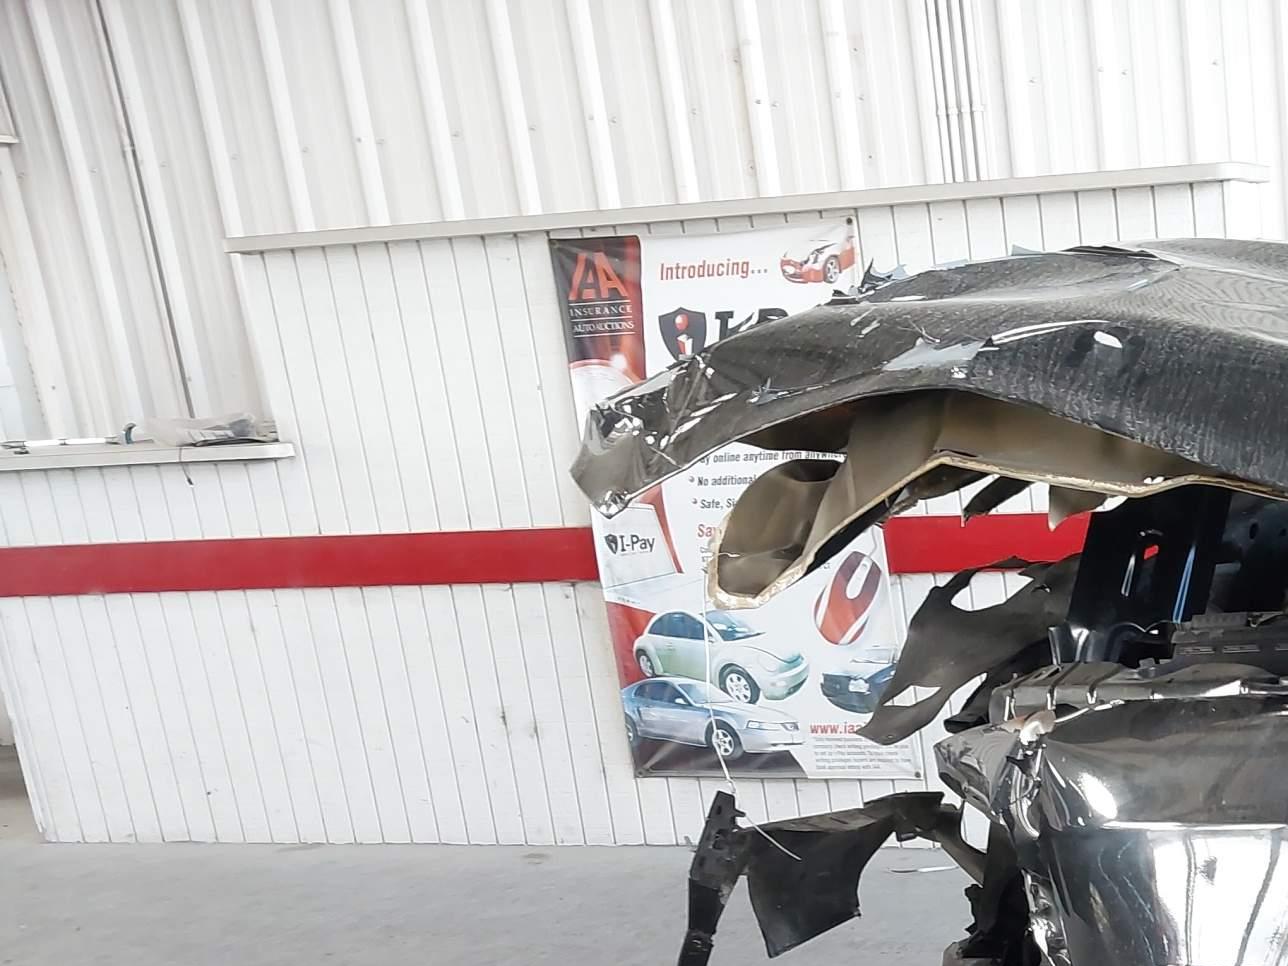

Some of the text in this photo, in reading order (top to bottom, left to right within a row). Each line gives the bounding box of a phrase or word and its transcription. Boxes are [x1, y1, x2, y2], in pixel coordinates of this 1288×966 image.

[569, 304, 633, 316] INSURANCE
[713, 452, 740, 463] online
[743, 450, 779, 463] anytime
[697, 476, 709, 486] No
[700, 498, 724, 509] Safe,
[619, 533, 656, 552] I-Pay
